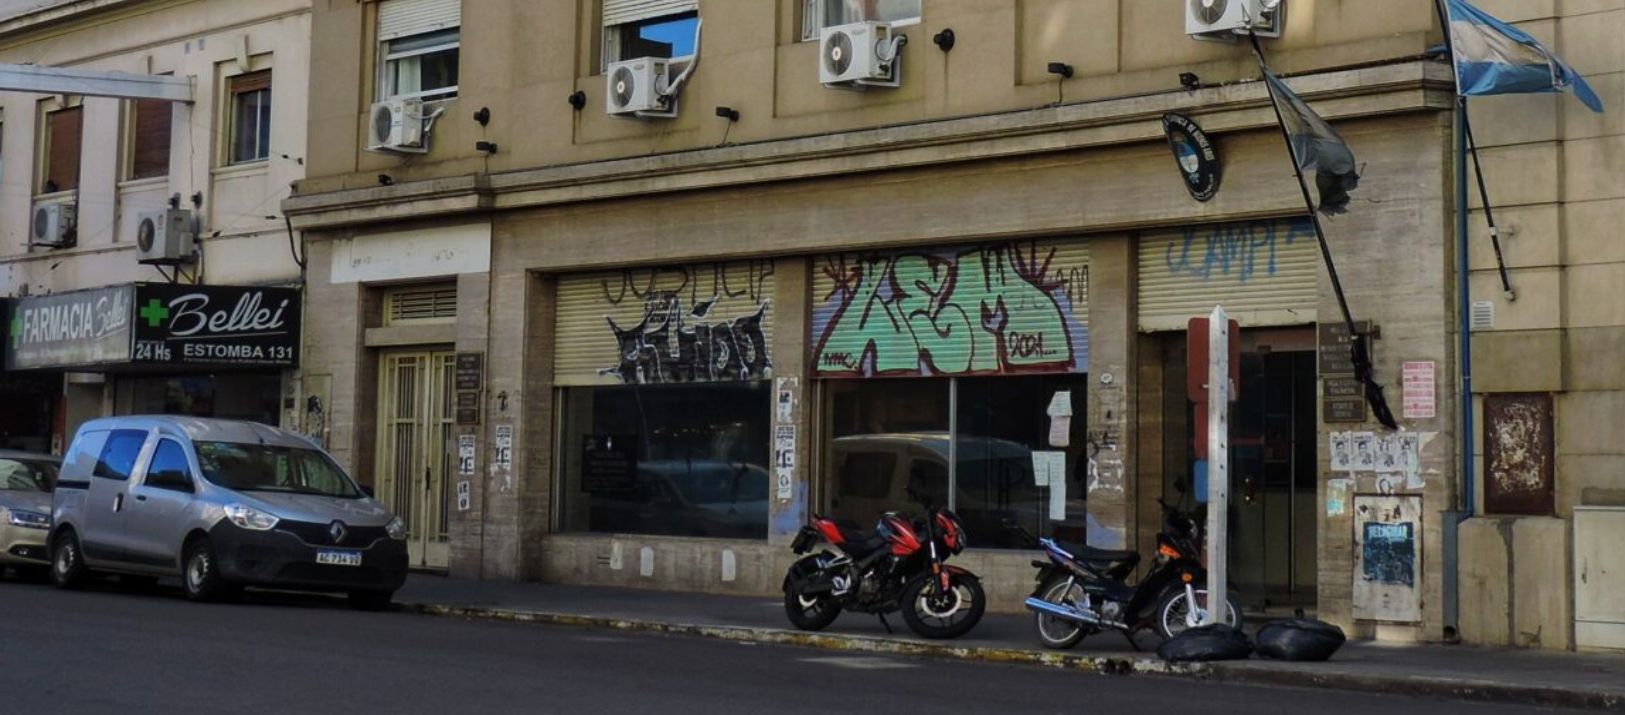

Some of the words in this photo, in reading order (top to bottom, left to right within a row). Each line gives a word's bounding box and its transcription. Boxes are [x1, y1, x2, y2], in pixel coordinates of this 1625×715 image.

[22, 302, 93, 344] FARMACIA
[168, 291, 289, 336] Bellei
[136, 342, 151, 360] 24
[155, 342, 171, 361] Hs
[183, 342, 264, 359] ESTOMBA
[267, 346, 293, 359] 131
